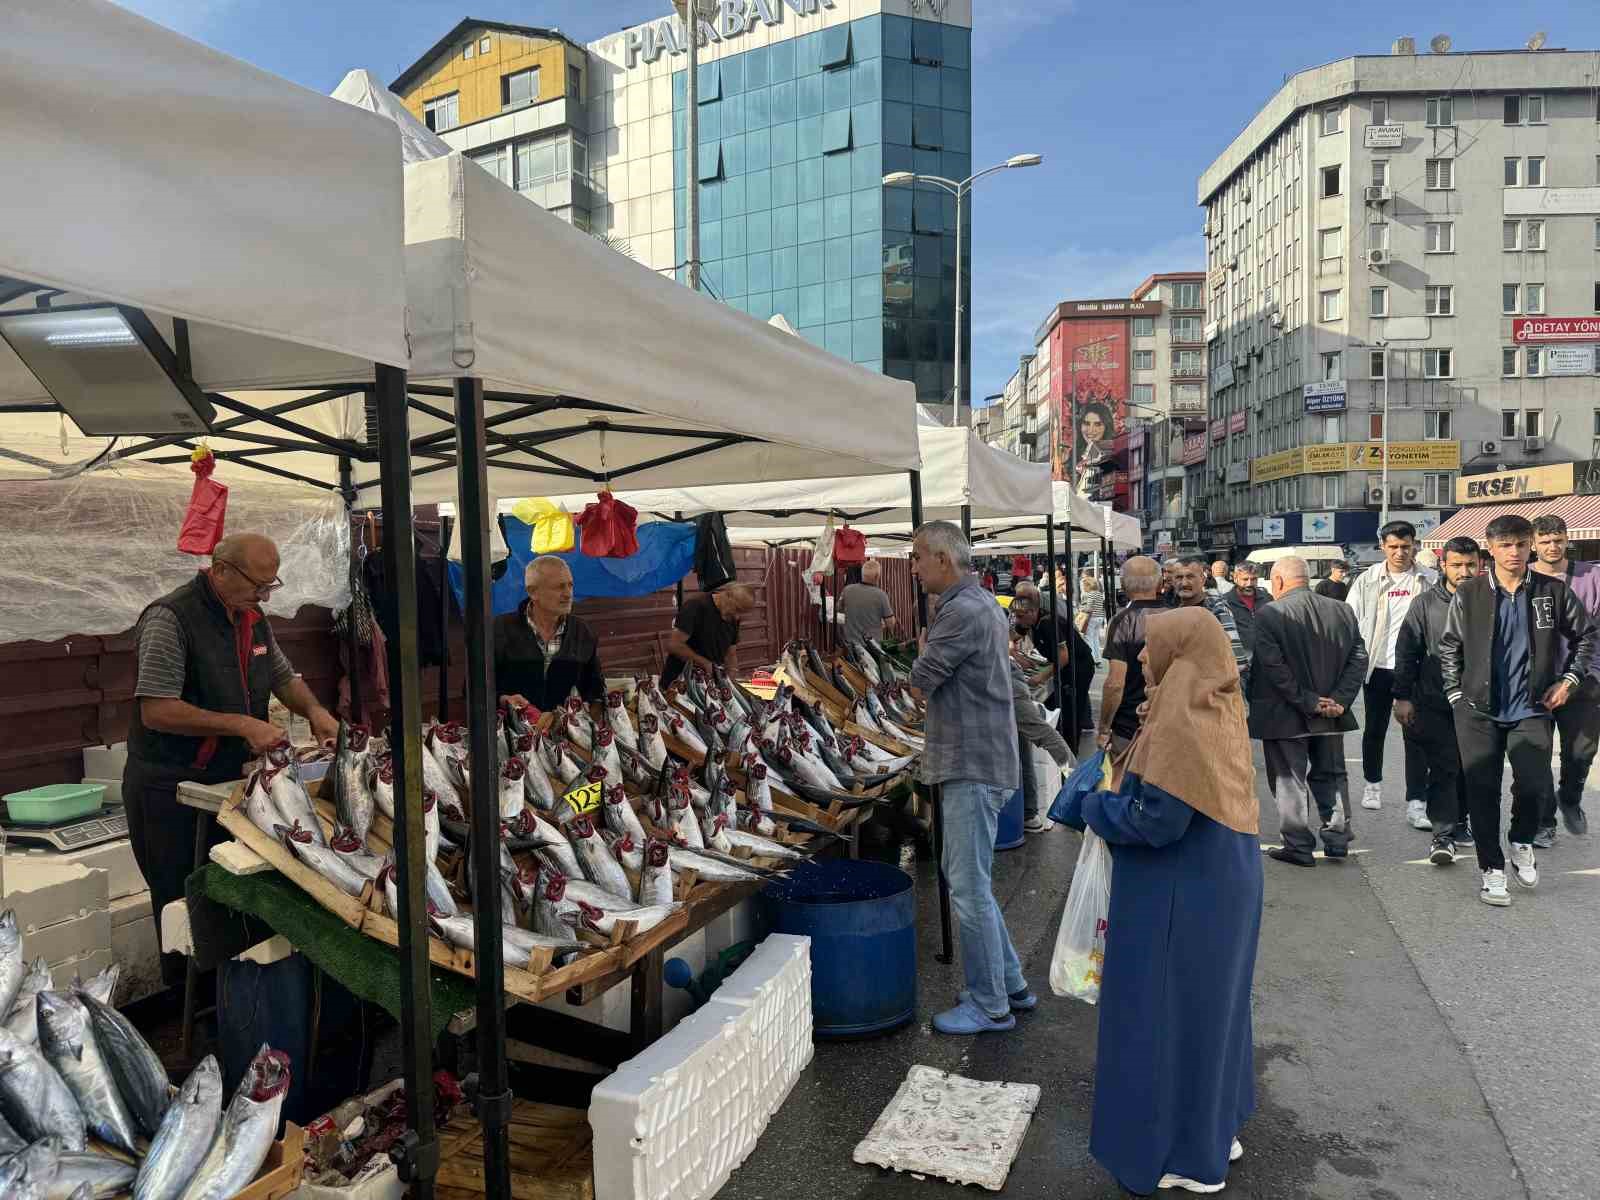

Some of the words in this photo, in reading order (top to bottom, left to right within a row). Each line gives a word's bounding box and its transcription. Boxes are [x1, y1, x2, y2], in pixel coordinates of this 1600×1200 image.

[1534, 322, 1571, 333] DETAY
[1573, 319, 1600, 332] YÖN
[1467, 474, 1529, 498] EKSEN
[1531, 596, 1554, 629] E
